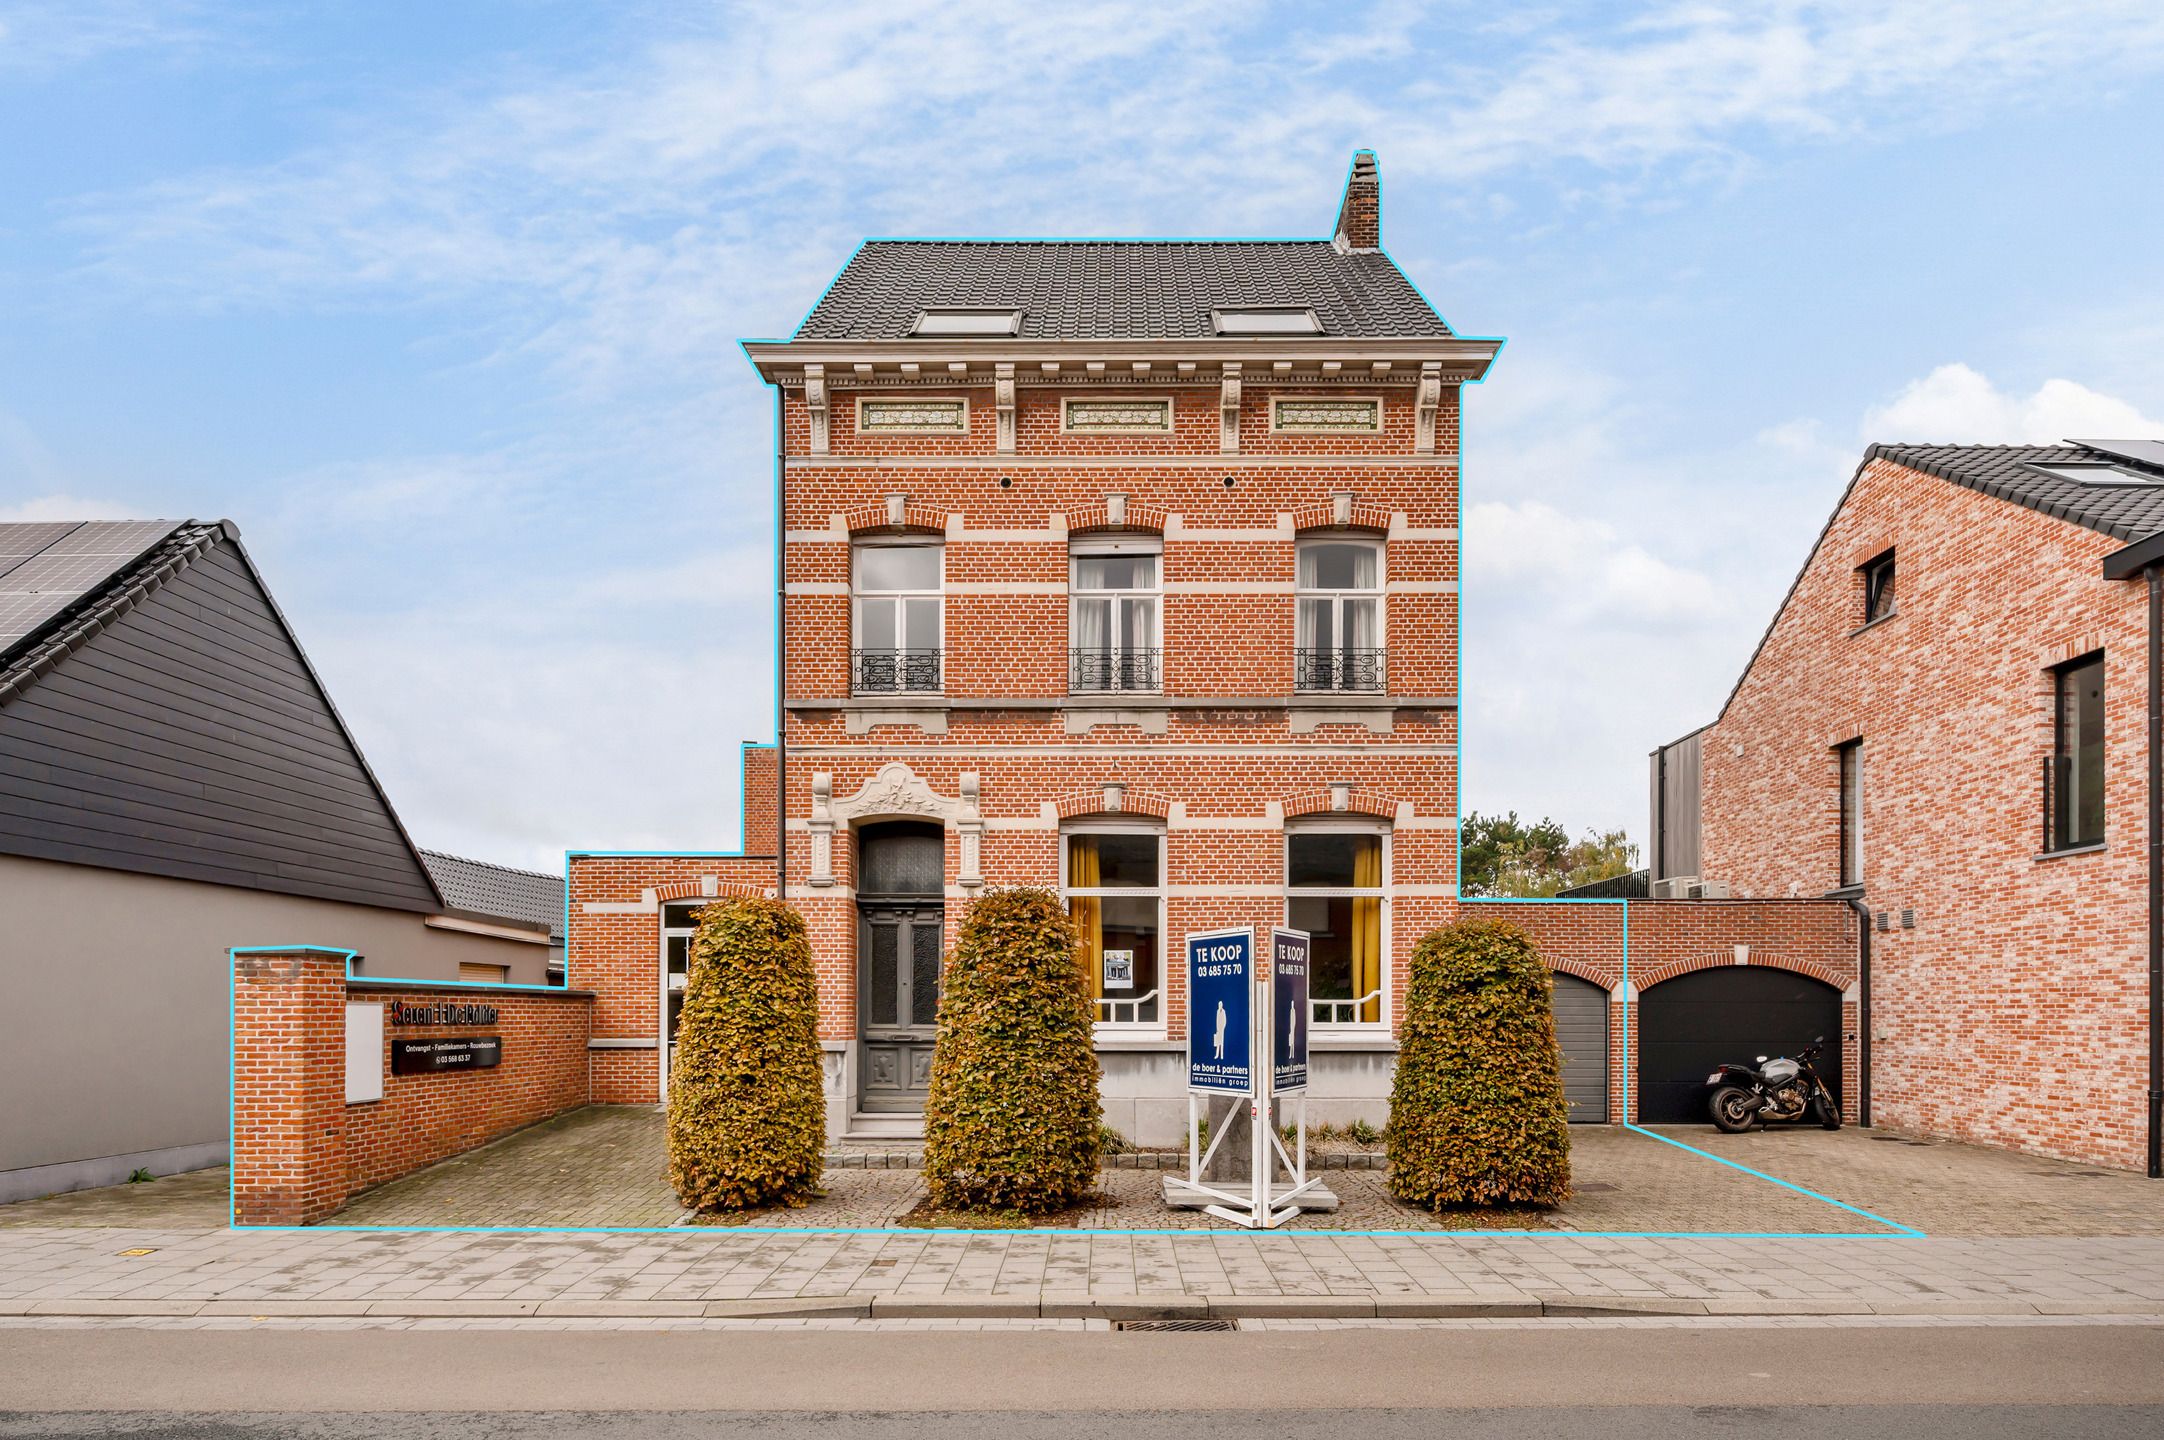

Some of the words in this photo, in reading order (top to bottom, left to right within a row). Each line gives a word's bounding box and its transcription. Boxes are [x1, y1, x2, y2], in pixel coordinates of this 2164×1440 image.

[1196, 947, 1208, 963] TE
[1210, 944, 1242, 962] KOOP
[1278, 944, 1286, 960] TE
[1287, 945, 1305, 962] KOOP
[1198, 965, 1208, 977] 03
[1208, 965, 1222, 976] 685
[1222, 964, 1232, 975] 75
[1233, 963, 1242, 975] 70
[1278, 963, 1285, 975] 03
[1285, 964, 1294, 975] 685
[1299, 965, 1305, 976] 70
[391, 1001, 435, 1026] Sereni
[446, 1004, 463, 1025] De
[405, 1044, 431, 1053] Ontvangst
[434, 1043, 467, 1051] Familiekamers
[458, 1054, 465, 1062] 63
[464, 1054, 471, 1062] 37
[1192, 1063, 1201, 1072] de
[1201, 1063, 1216, 1073] boer
[1216, 1064, 1221, 1073] &
[1222, 1065, 1248, 1075] partners
[1229, 1079, 1248, 1087] groep
